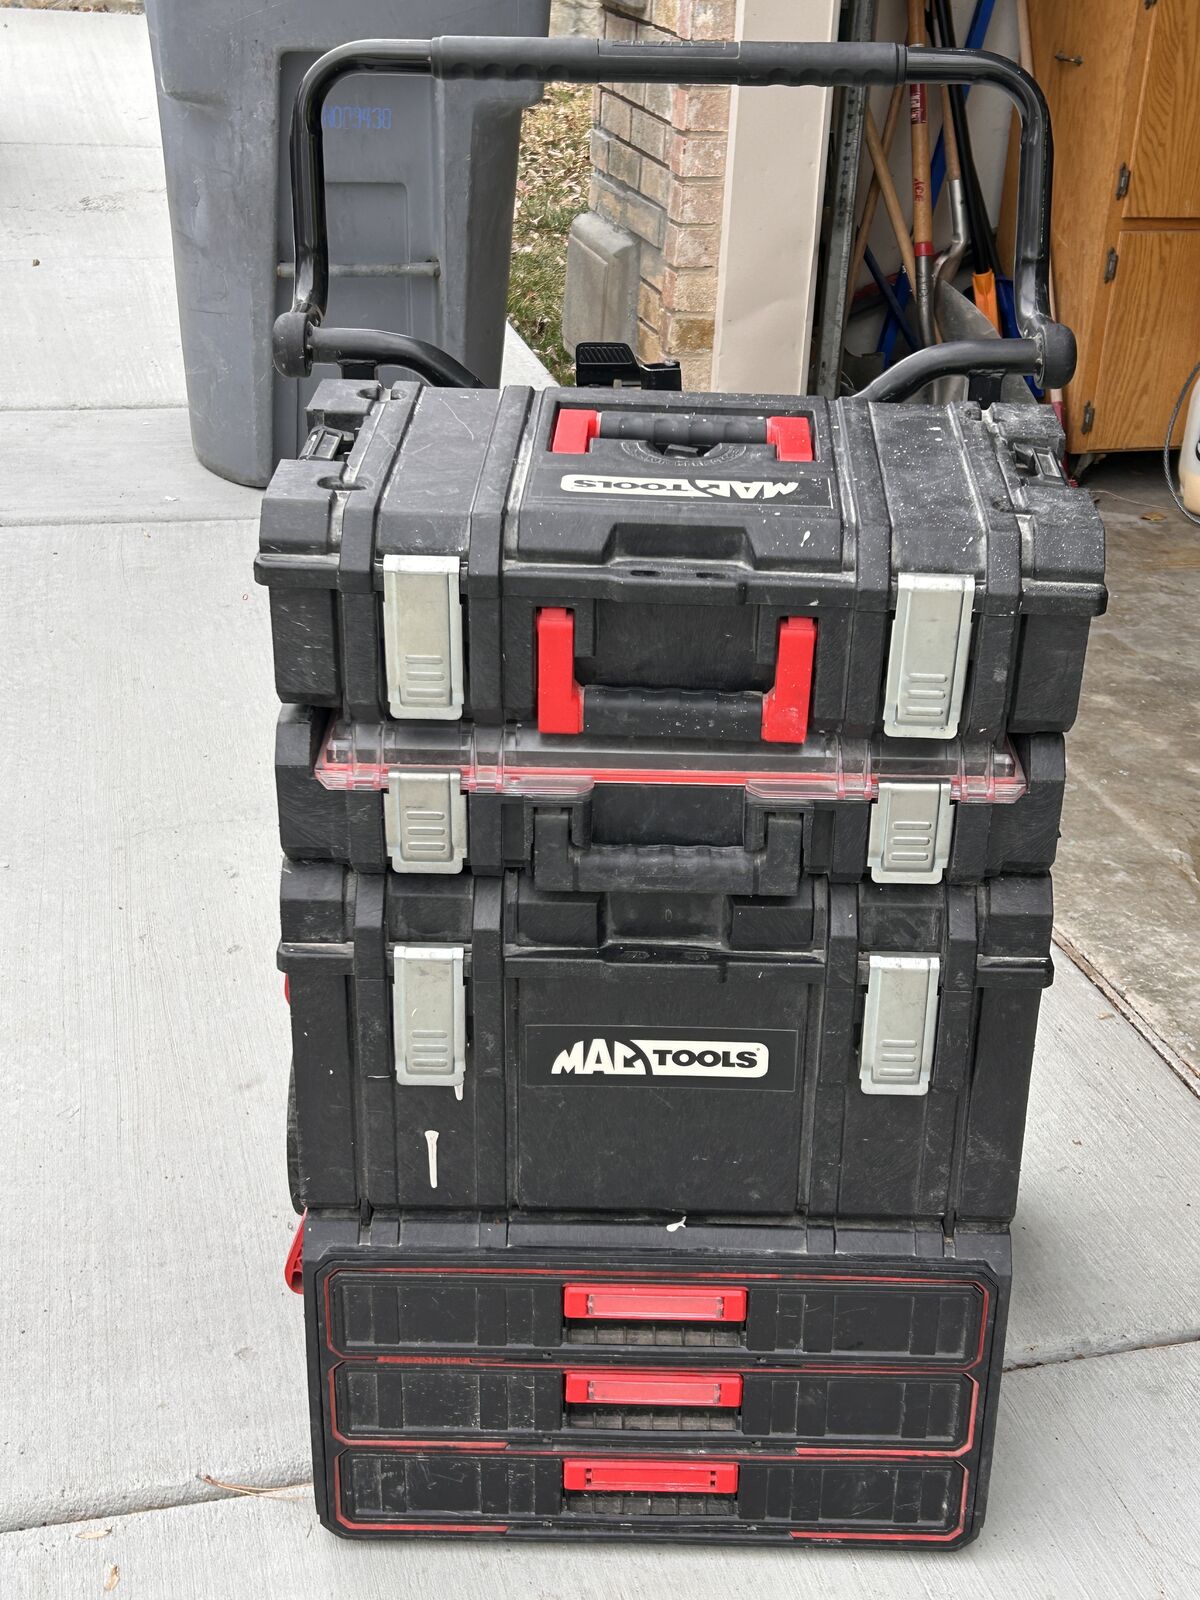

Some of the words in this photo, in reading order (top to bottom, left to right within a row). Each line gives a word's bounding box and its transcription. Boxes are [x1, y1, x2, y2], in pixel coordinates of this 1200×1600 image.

[573, 479, 689, 492] TOOLS
[695, 479, 799, 499] MAC
[551, 1038, 647, 1075] MAC
[653, 1049, 758, 1069] TOOLS
